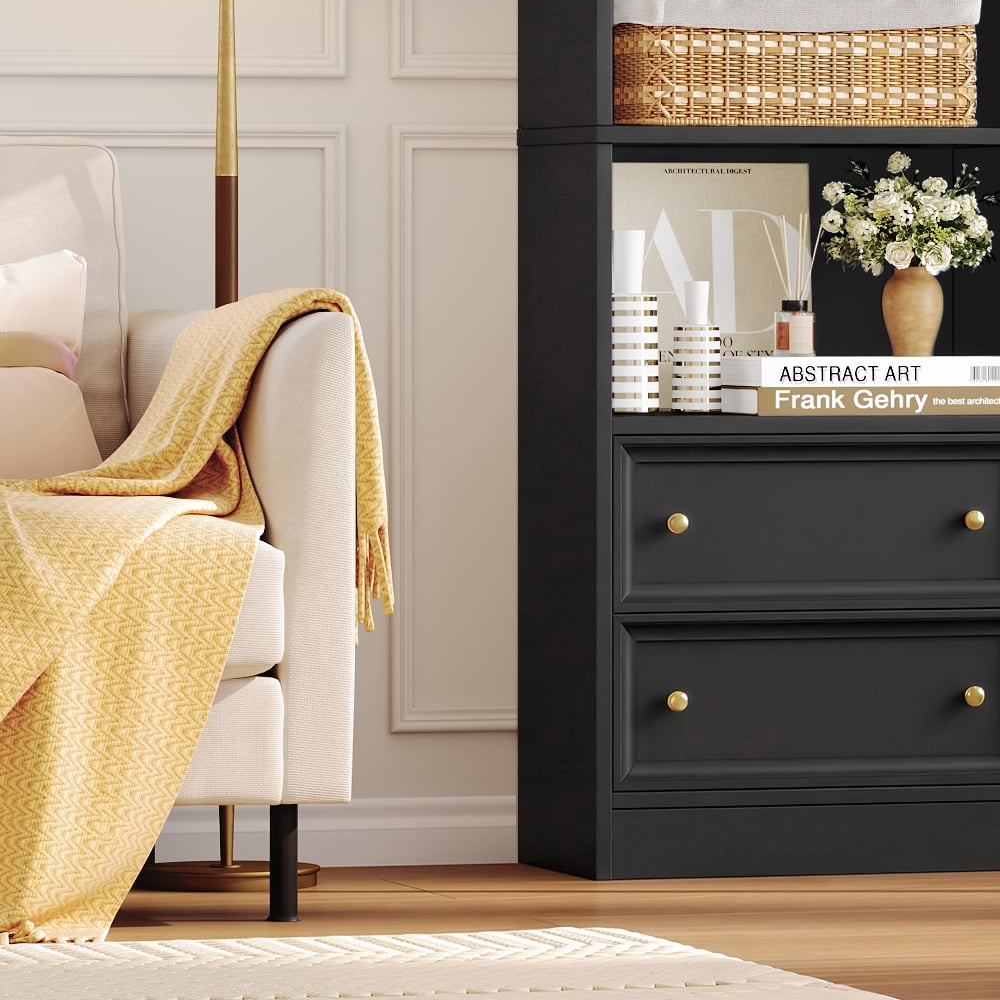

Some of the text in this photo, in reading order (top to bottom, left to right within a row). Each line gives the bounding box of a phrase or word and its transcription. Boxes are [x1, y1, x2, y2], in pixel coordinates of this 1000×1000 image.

[779, 365, 921, 382] ABSTRACT ART
[775, 389, 846, 409] Frank
[853, 389, 928, 413] Gehry
[933, 396, 946, 405] the
[947, 396, 965, 405] best
